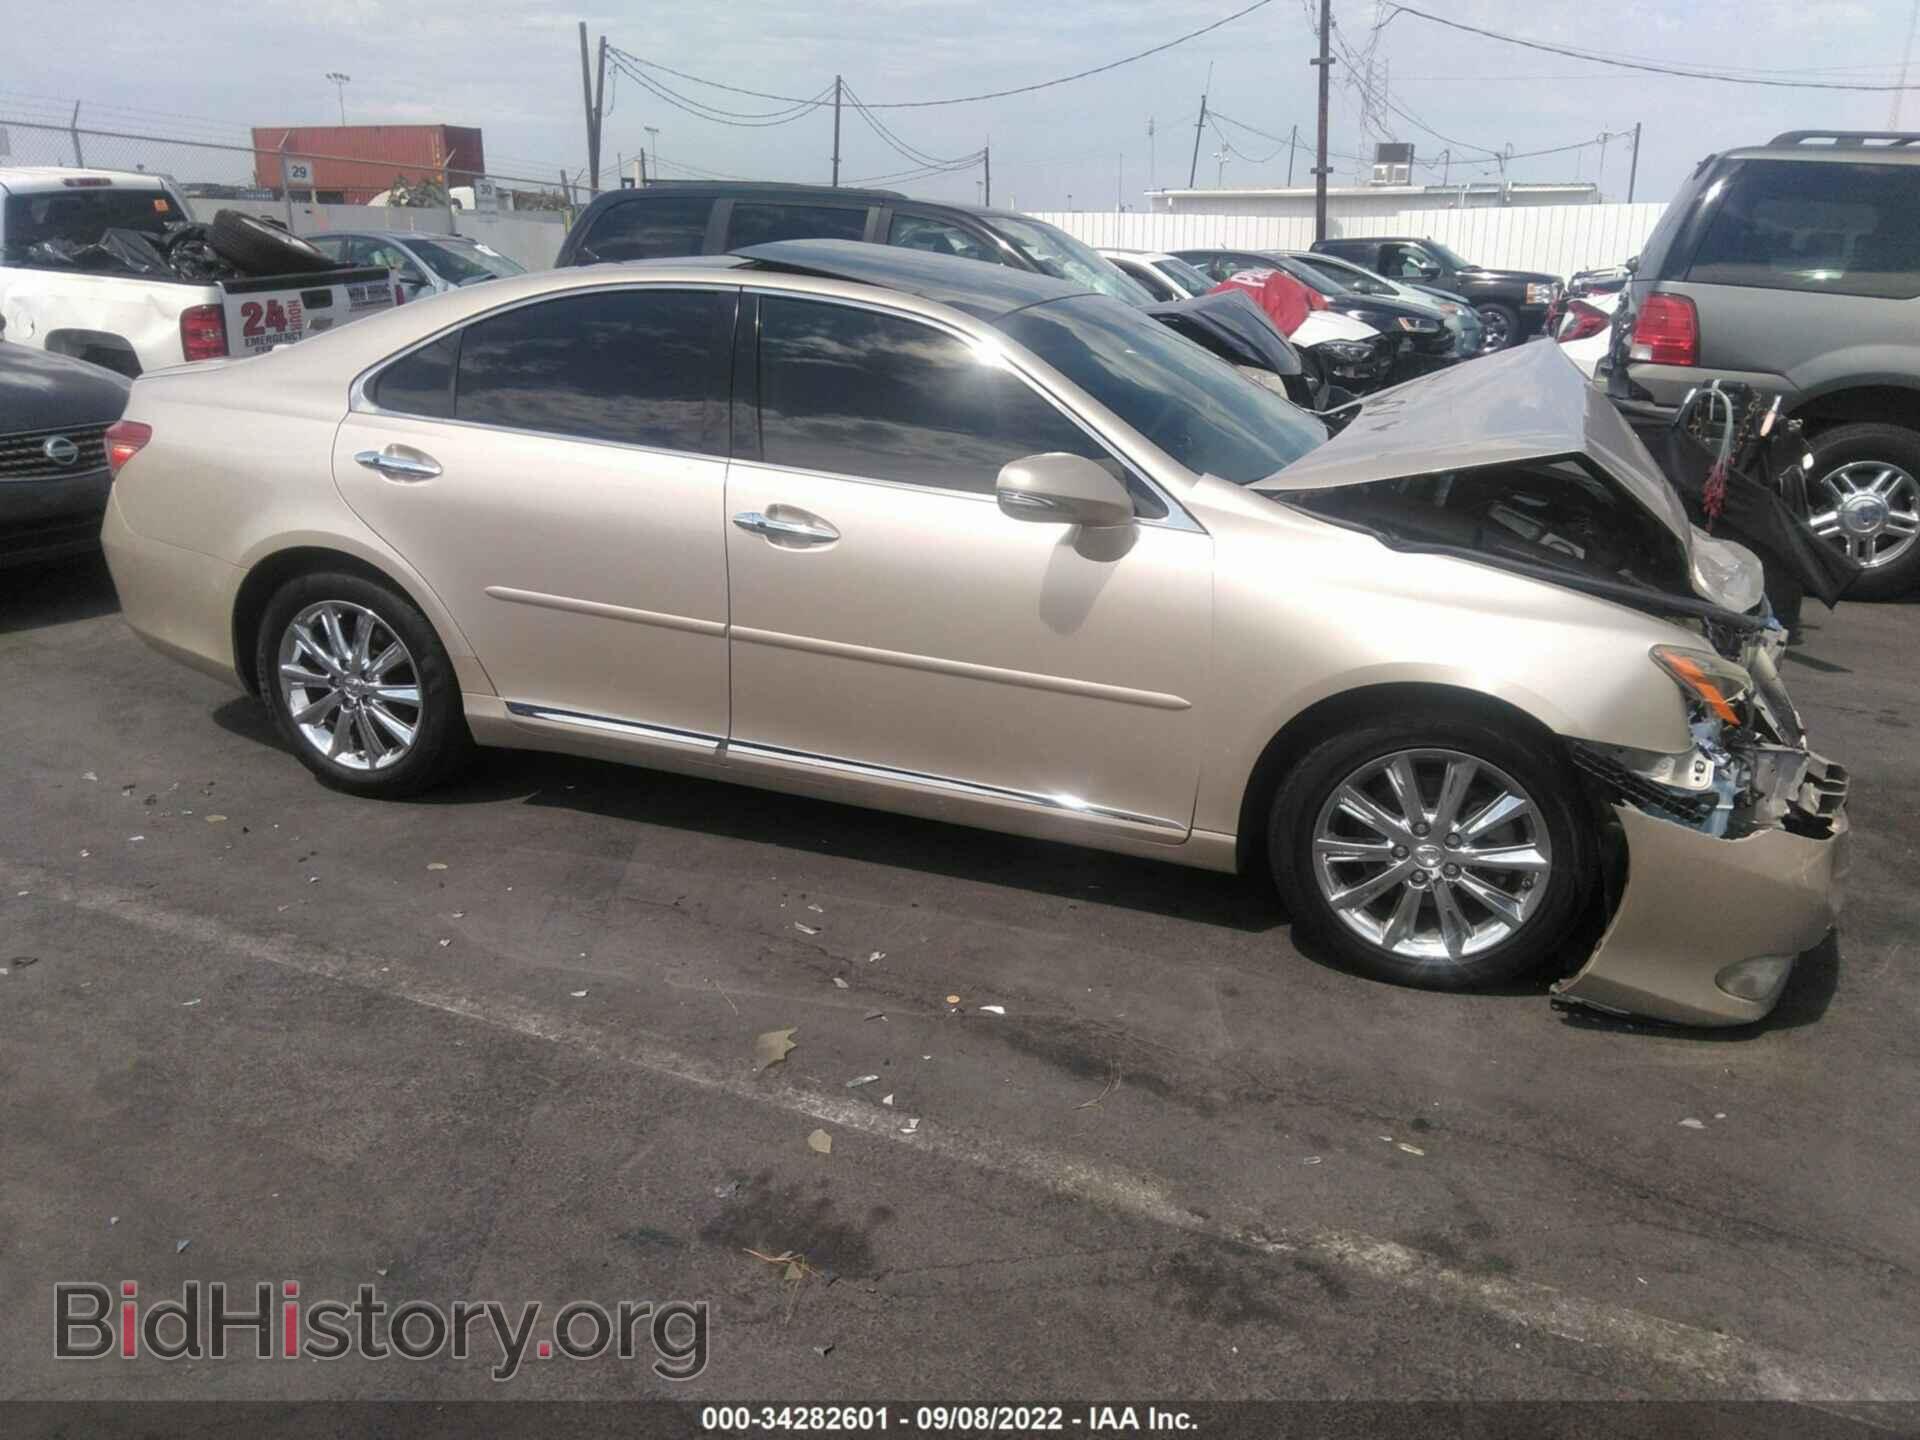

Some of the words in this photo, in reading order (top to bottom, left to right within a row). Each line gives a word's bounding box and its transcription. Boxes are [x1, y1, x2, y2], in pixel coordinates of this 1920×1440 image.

[290, 164, 306, 179] 29
[241, 299, 288, 337] 24
[244, 331, 302, 347] EMERGENCY
